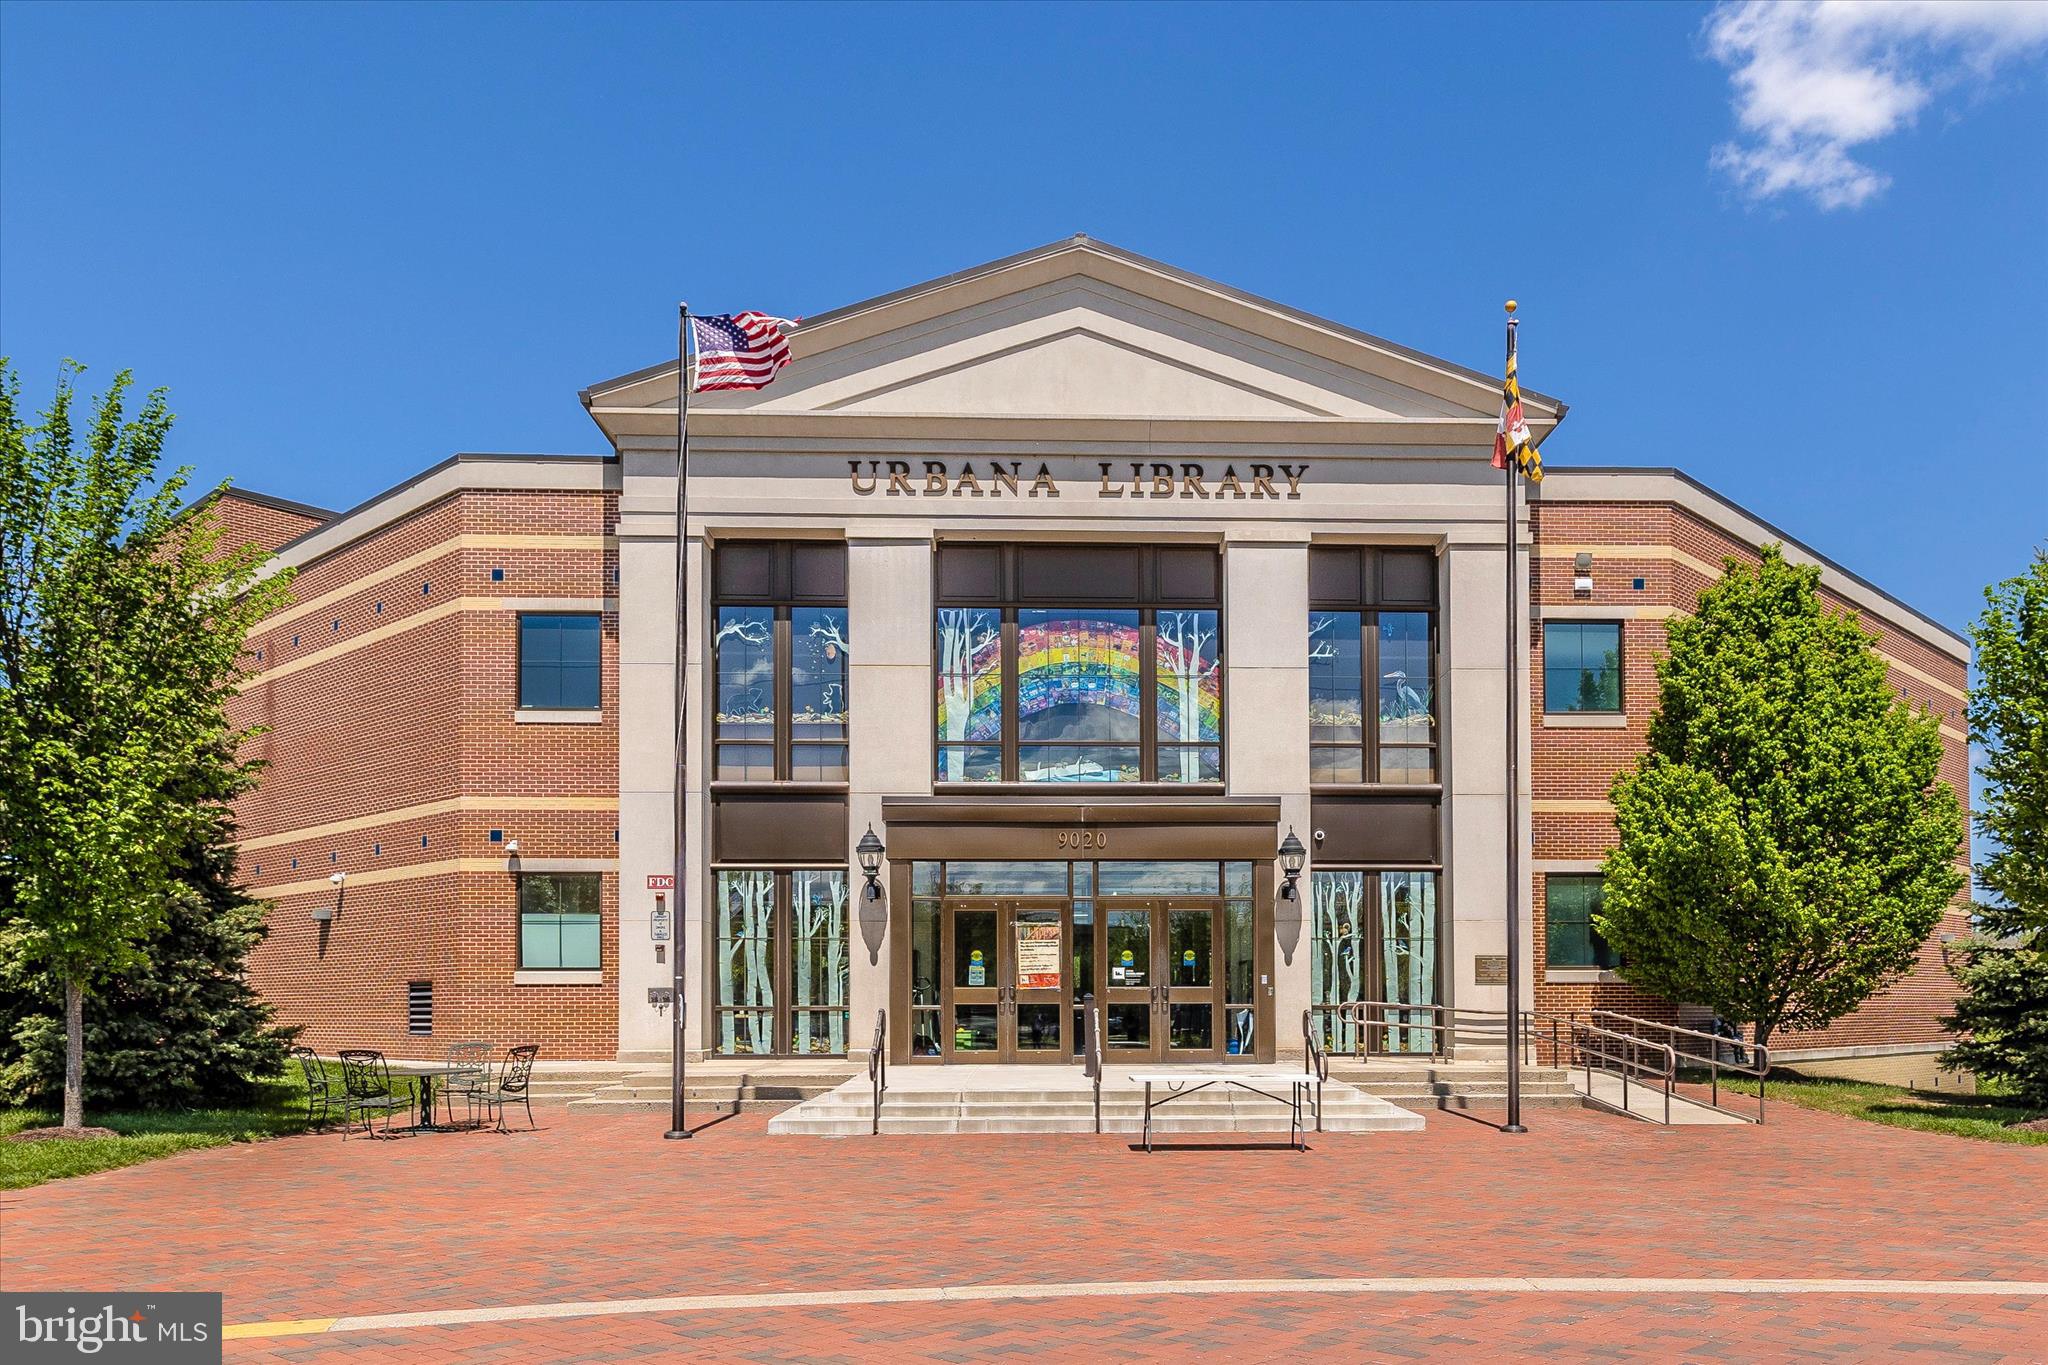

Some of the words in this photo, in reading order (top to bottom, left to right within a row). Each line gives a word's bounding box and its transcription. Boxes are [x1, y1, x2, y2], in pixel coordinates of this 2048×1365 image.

[847, 459, 1060, 497] URBANA
[1098, 461, 1310, 499] LIBRARY
[1058, 831, 1107, 848] 9020
[648, 877, 675, 887] FDC
